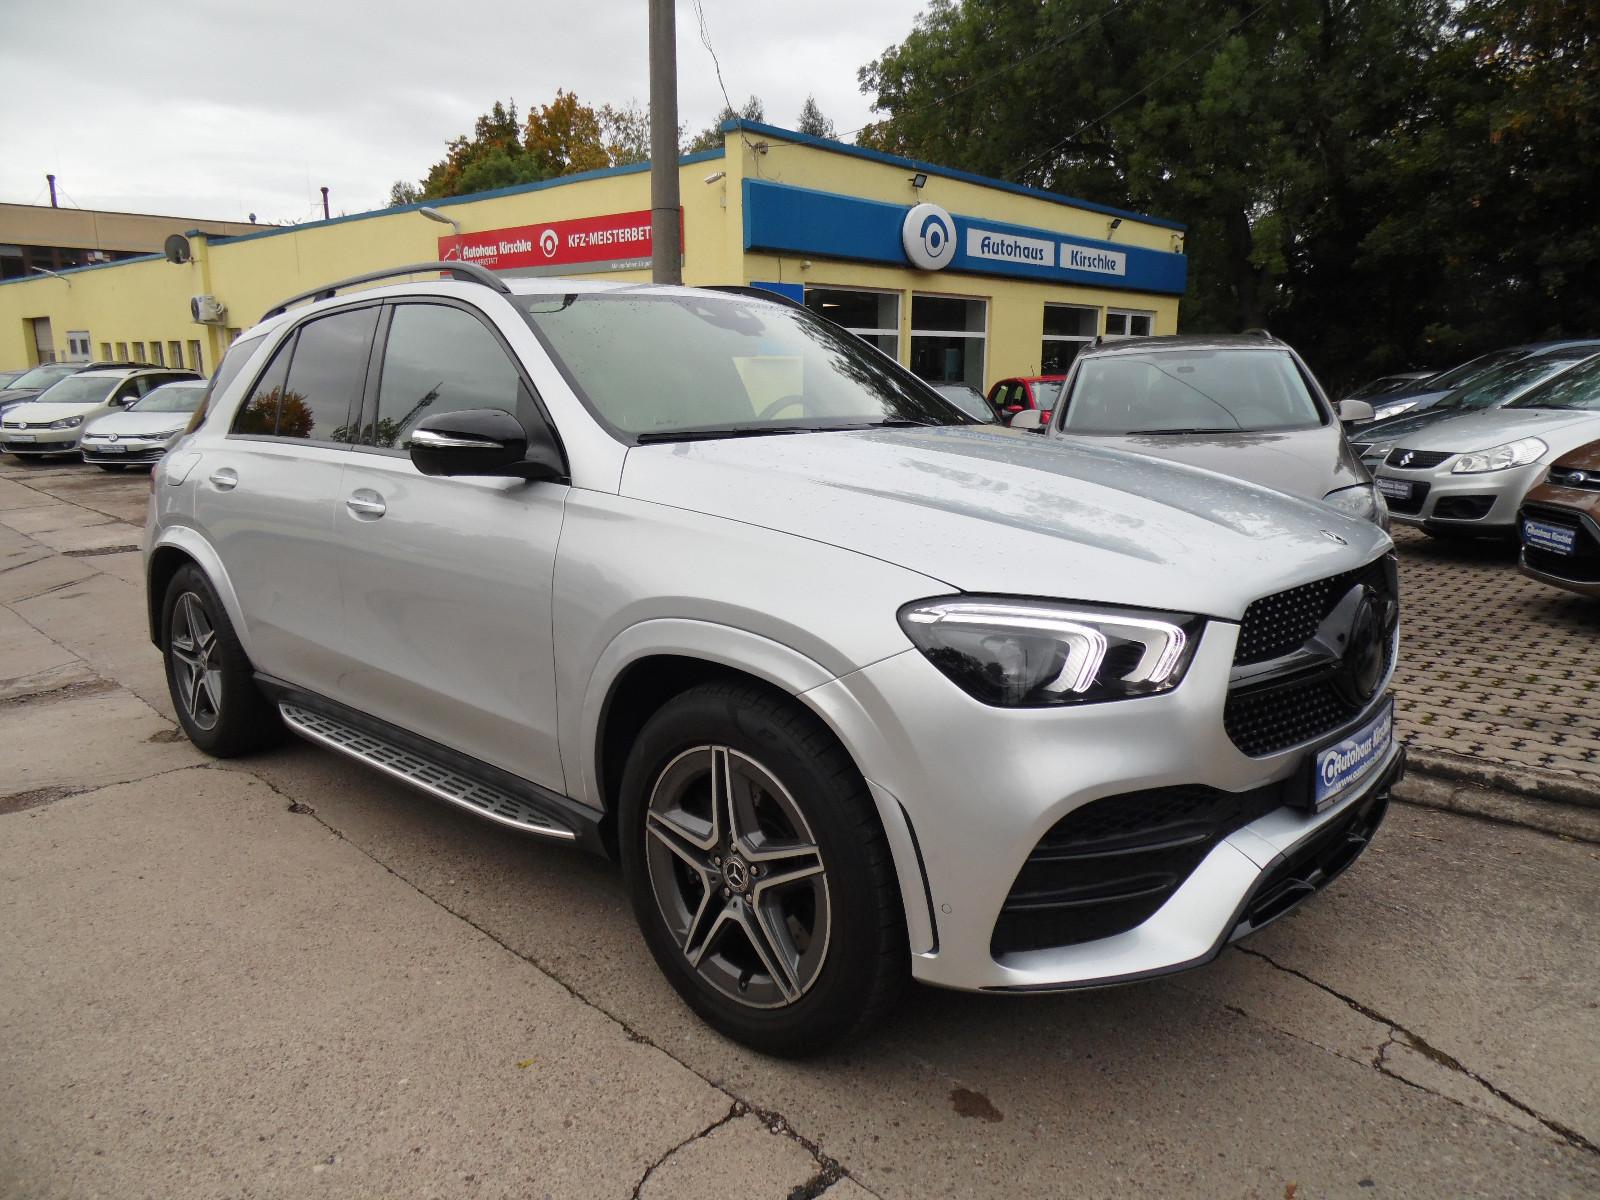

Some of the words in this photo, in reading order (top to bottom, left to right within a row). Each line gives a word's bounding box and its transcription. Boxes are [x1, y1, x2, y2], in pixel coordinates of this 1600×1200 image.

[463, 243, 498, 259] Autohaus
[499, 239, 532, 255] Kirschke
[568, 225, 653, 248] KFZ-MEISTERBET
[980, 236, 1044, 261] Autohaus
[1070, 249, 1117, 271] Kirschke
[1334, 738, 1372, 777] Autohaus
